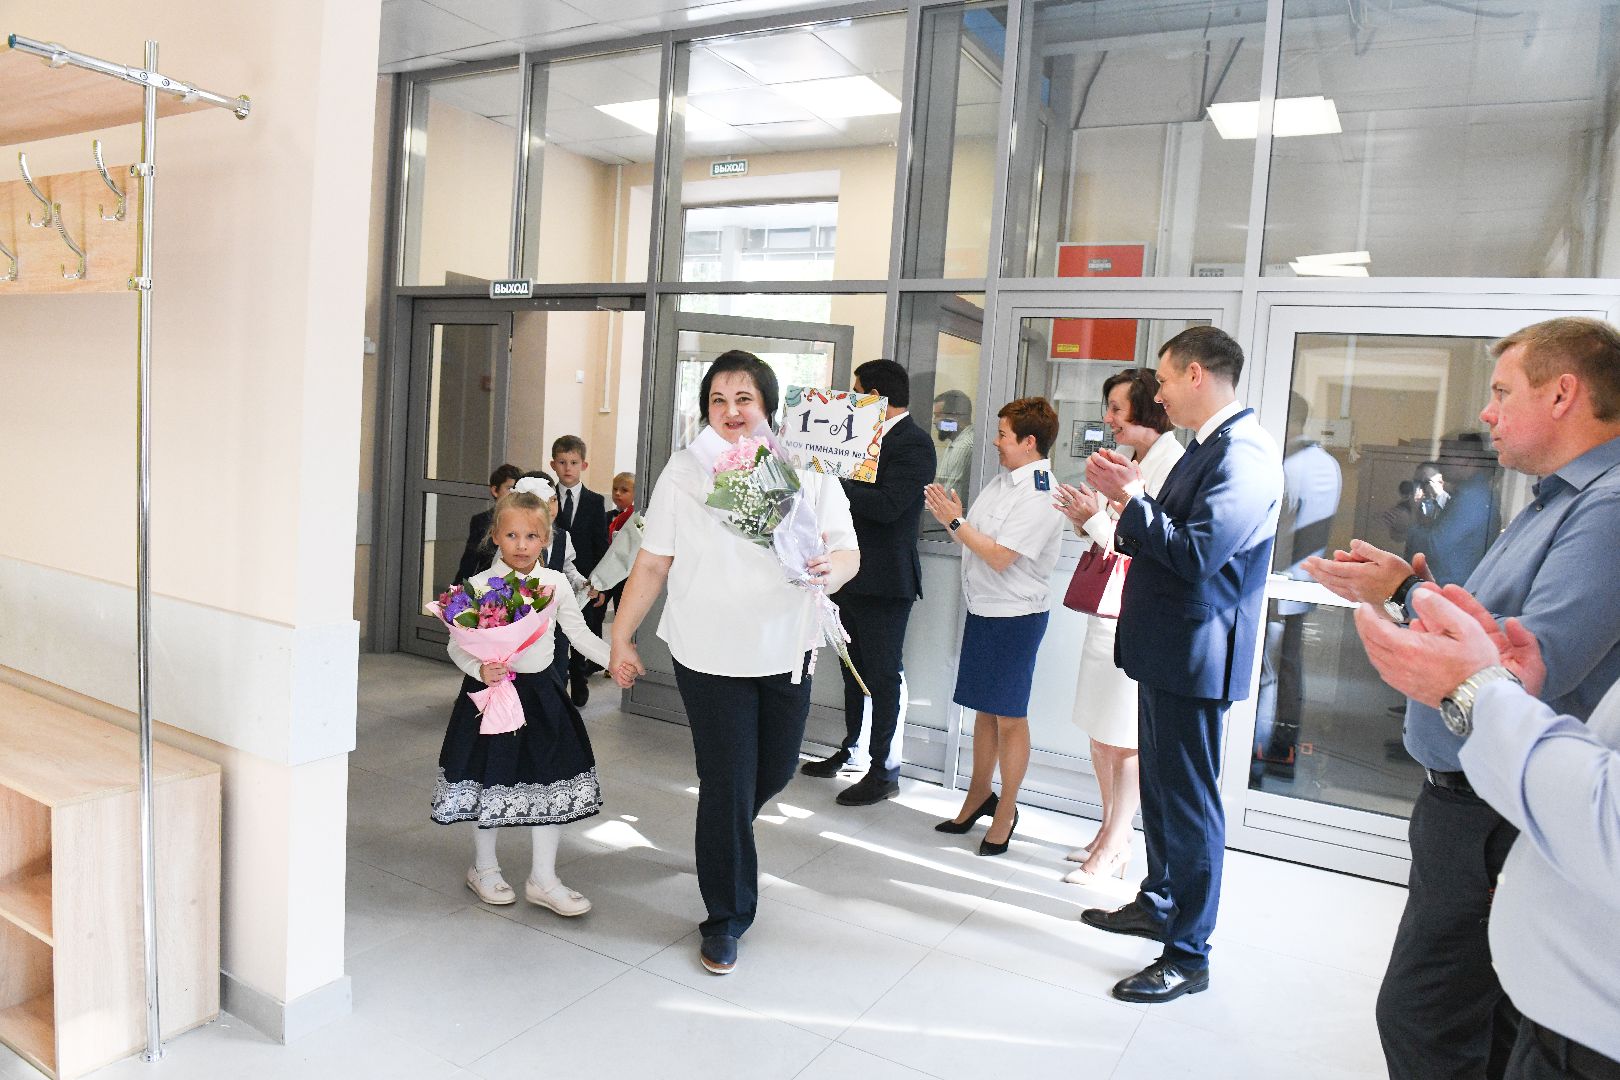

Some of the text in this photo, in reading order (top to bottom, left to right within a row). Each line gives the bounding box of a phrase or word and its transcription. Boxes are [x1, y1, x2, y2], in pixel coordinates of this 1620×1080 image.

[714, 162, 745, 174] ВЫХОД
[494, 283, 529, 294] ВЫХОД
[785, 440, 867, 460] МОУ ГИМНАЗИЯ №1
